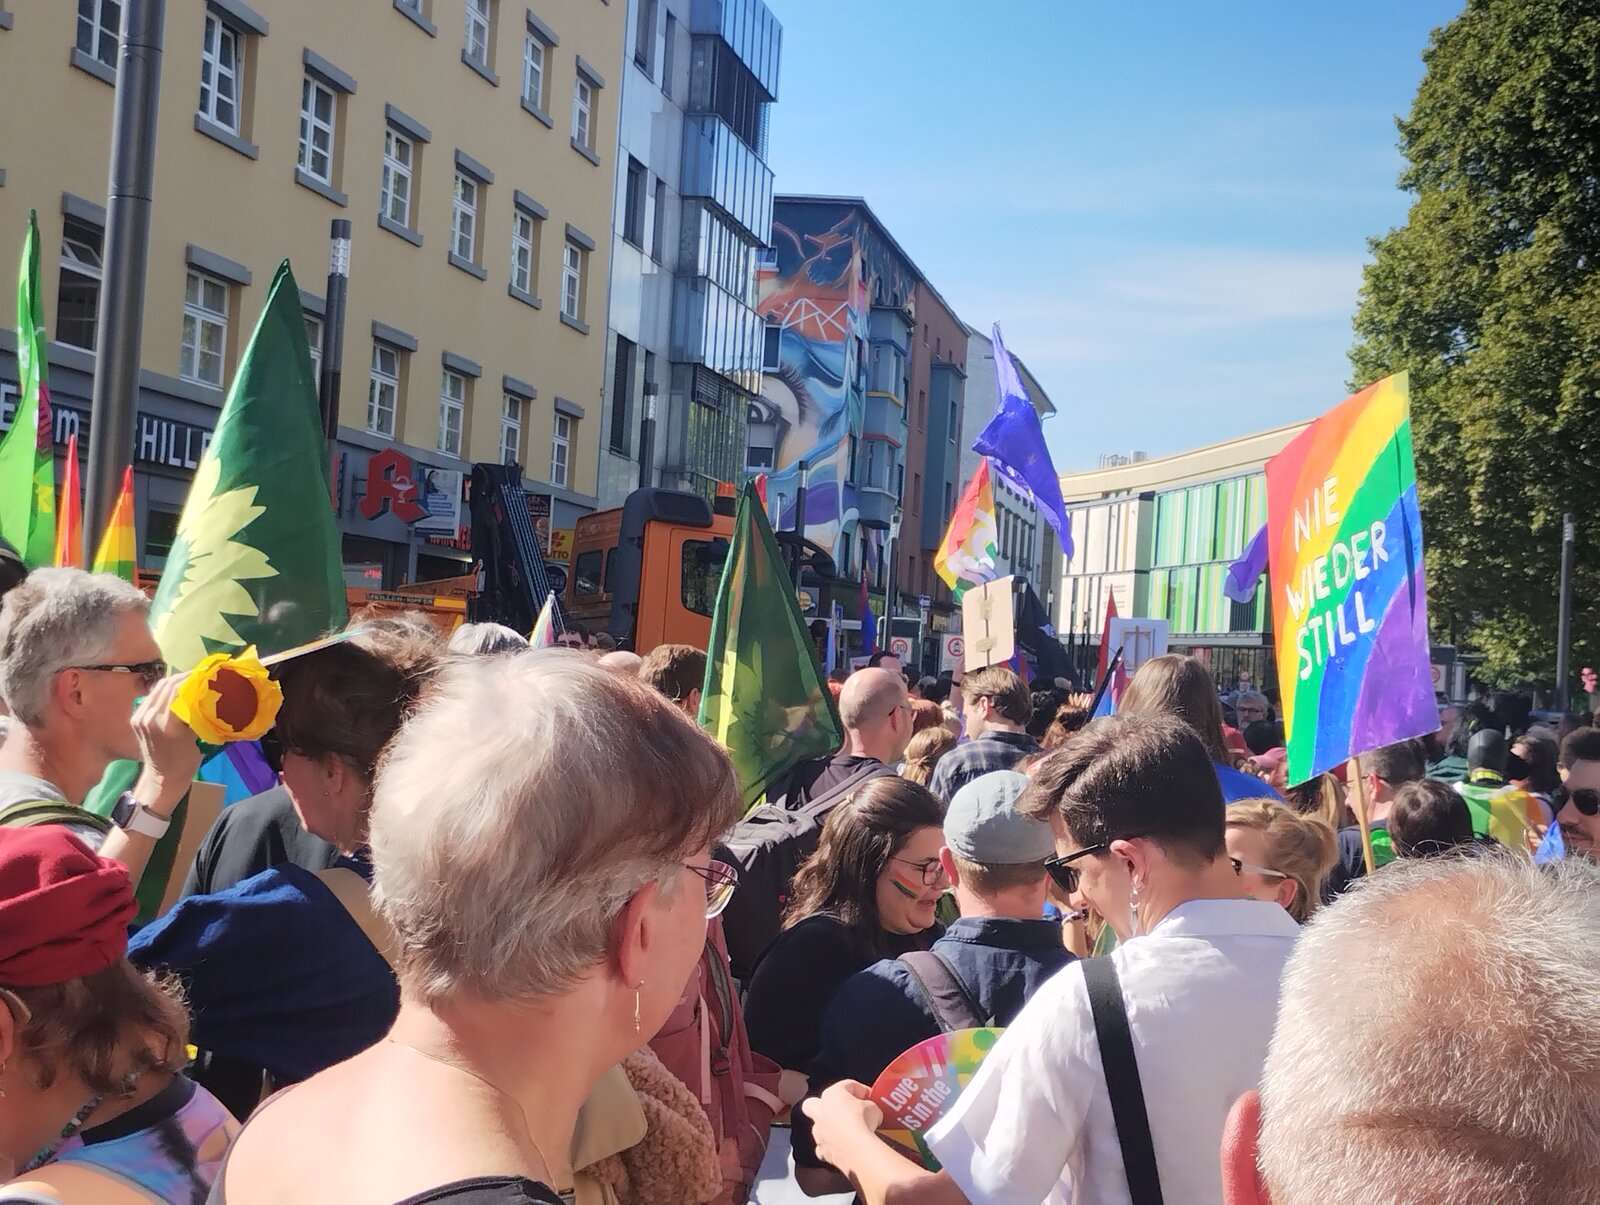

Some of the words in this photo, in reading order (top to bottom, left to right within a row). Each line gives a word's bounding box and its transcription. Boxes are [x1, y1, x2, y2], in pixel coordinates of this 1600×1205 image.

[134, 417, 212, 469] HILL
[1294, 474, 1340, 552] NIE
[1286, 520, 1389, 621] WIEDER
[1296, 591, 1376, 681] STILL
[880, 1077, 919, 1111] Love
[906, 1102, 933, 1122] in
[920, 1080, 952, 1108] the
[896, 1115, 922, 1131] is
